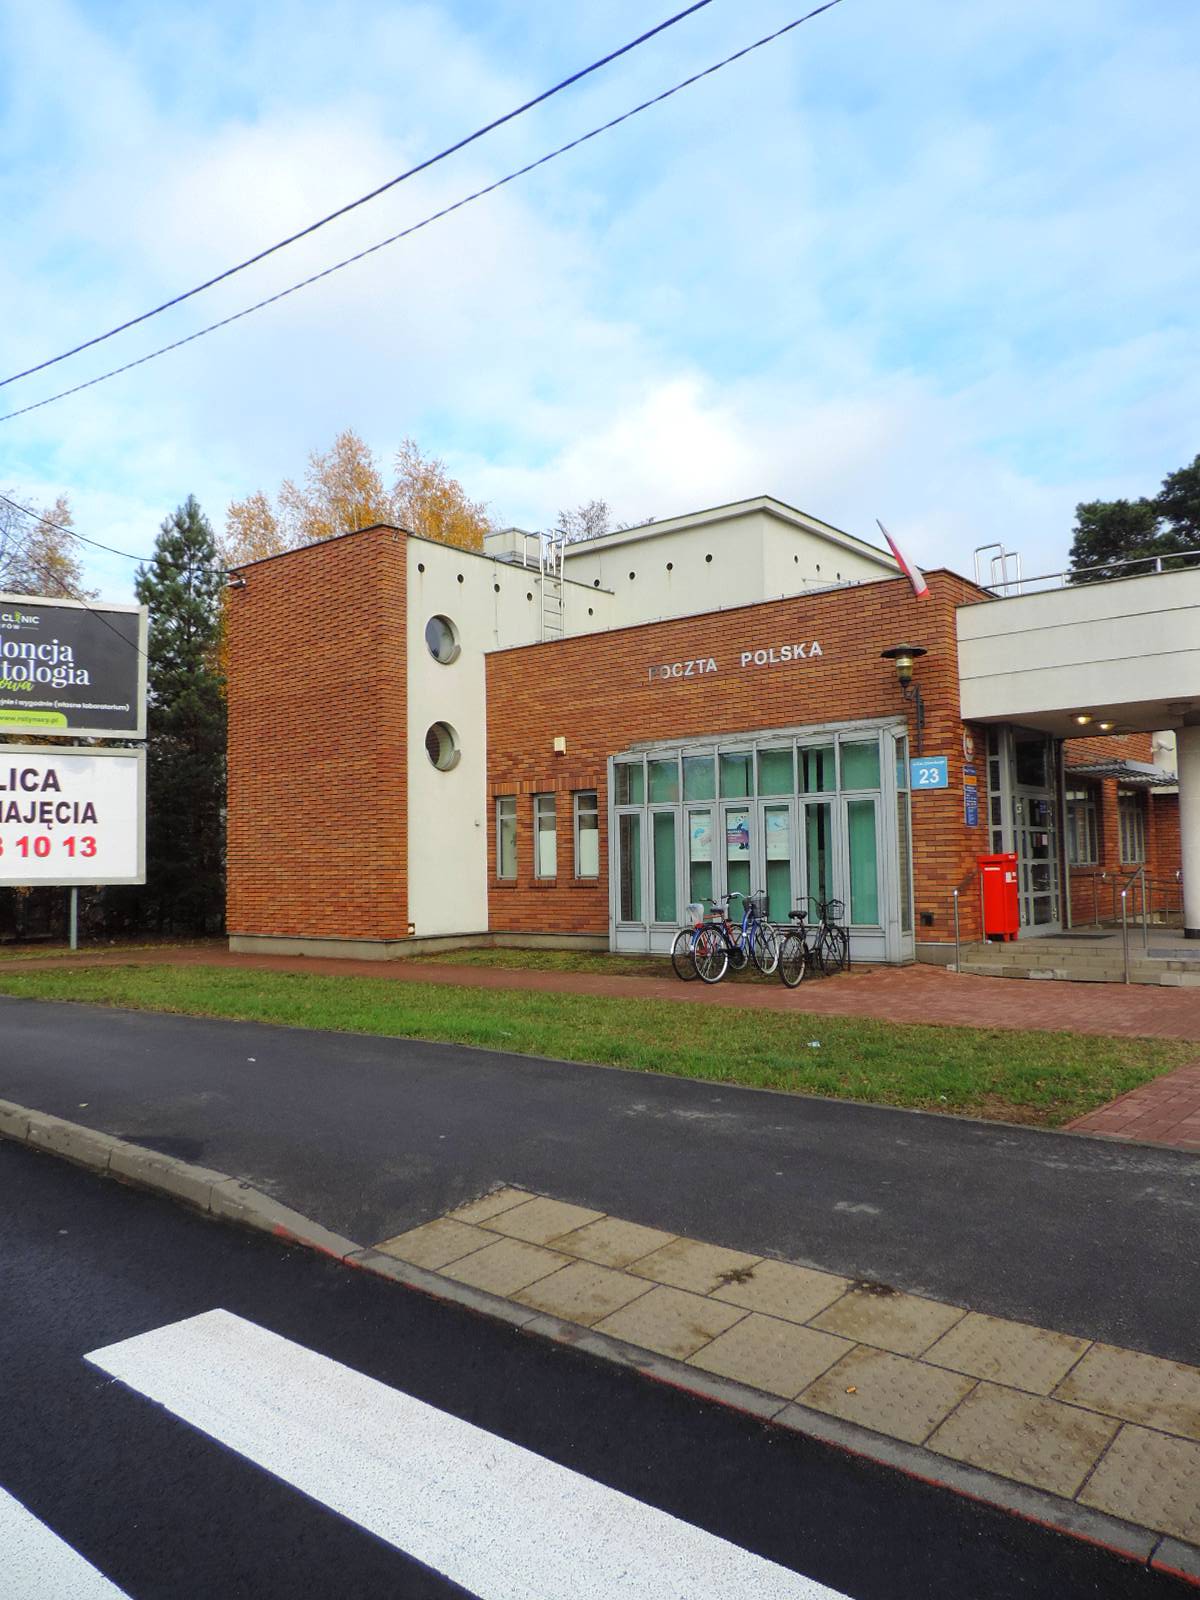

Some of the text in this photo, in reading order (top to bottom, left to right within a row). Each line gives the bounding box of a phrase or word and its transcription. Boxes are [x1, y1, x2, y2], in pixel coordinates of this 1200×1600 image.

[0, 635, 73, 664] oncja
[647, 640, 824, 682] POCZTA POLSKA
[919, 767, 940, 785] 23
[16, 836, 51, 857] 10
[63, 836, 97, 857] 13
